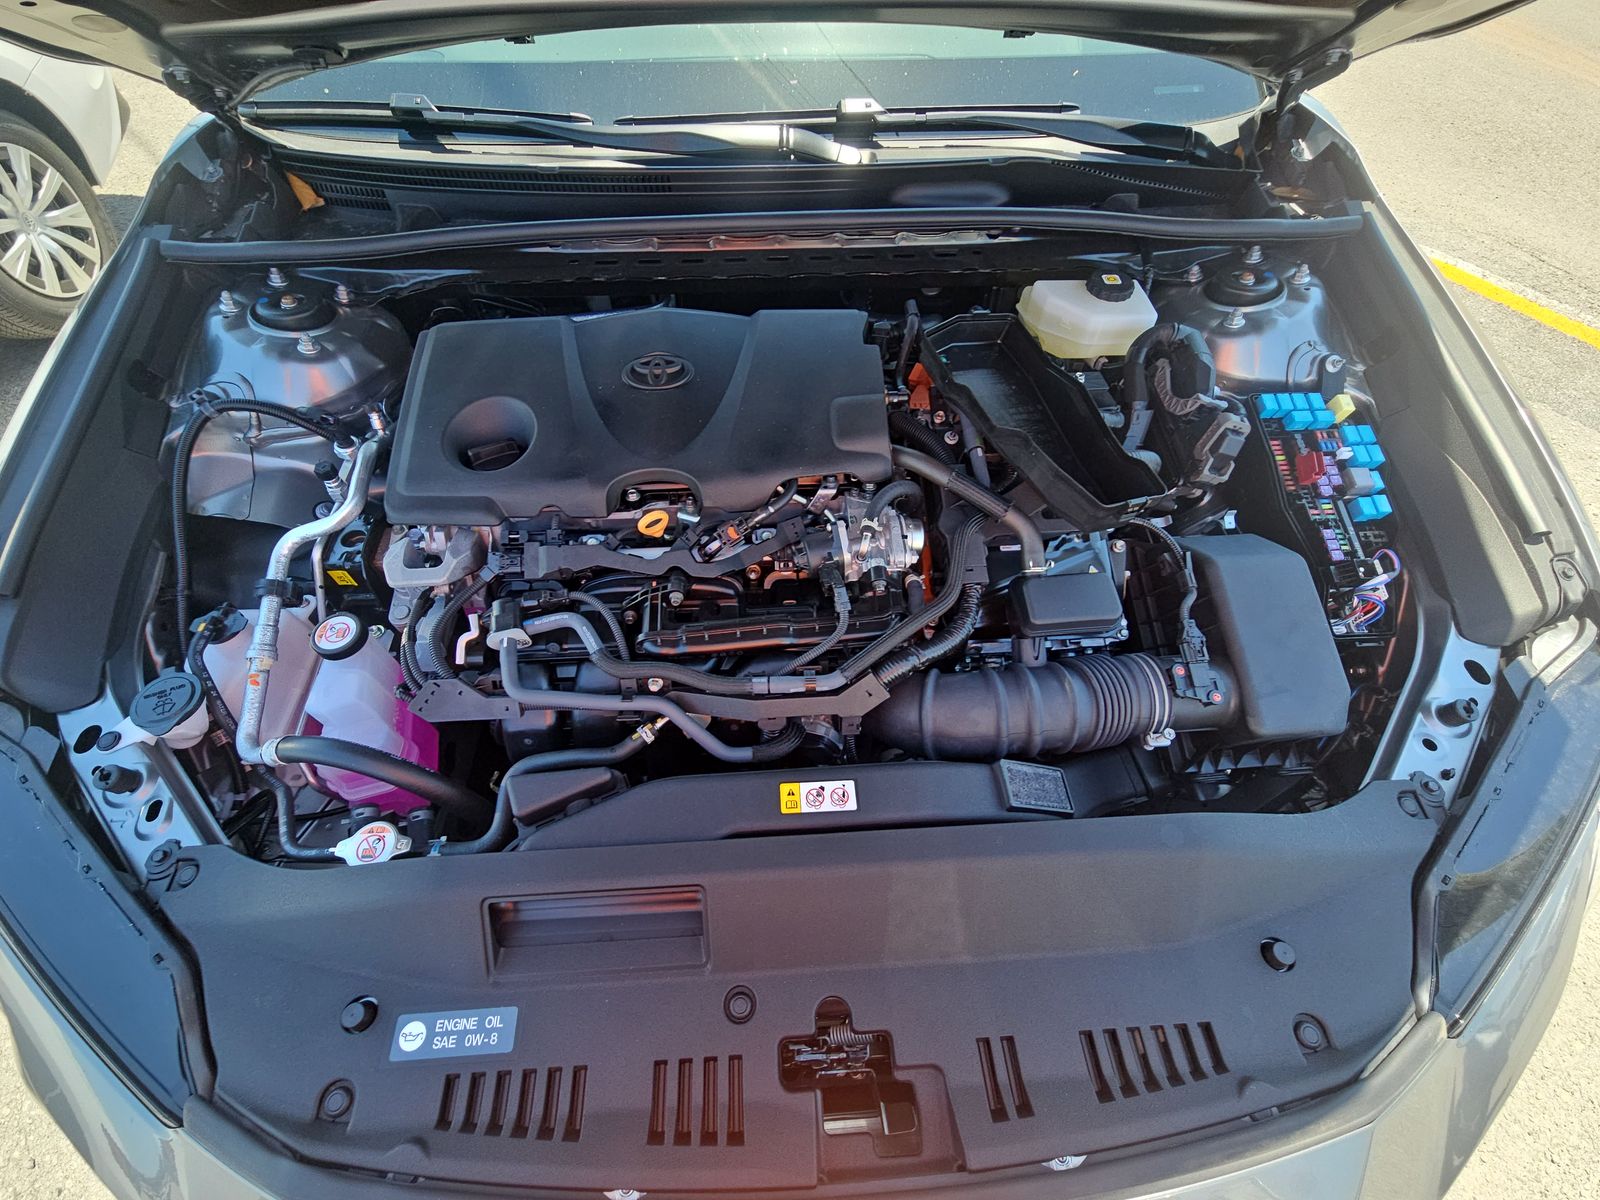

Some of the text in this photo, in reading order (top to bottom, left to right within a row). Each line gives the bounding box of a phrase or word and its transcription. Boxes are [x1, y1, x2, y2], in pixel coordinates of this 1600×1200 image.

[435, 1015, 504, 1032] ENGINE OIL
[432, 1032, 498, 1049] SAE 0W-8
